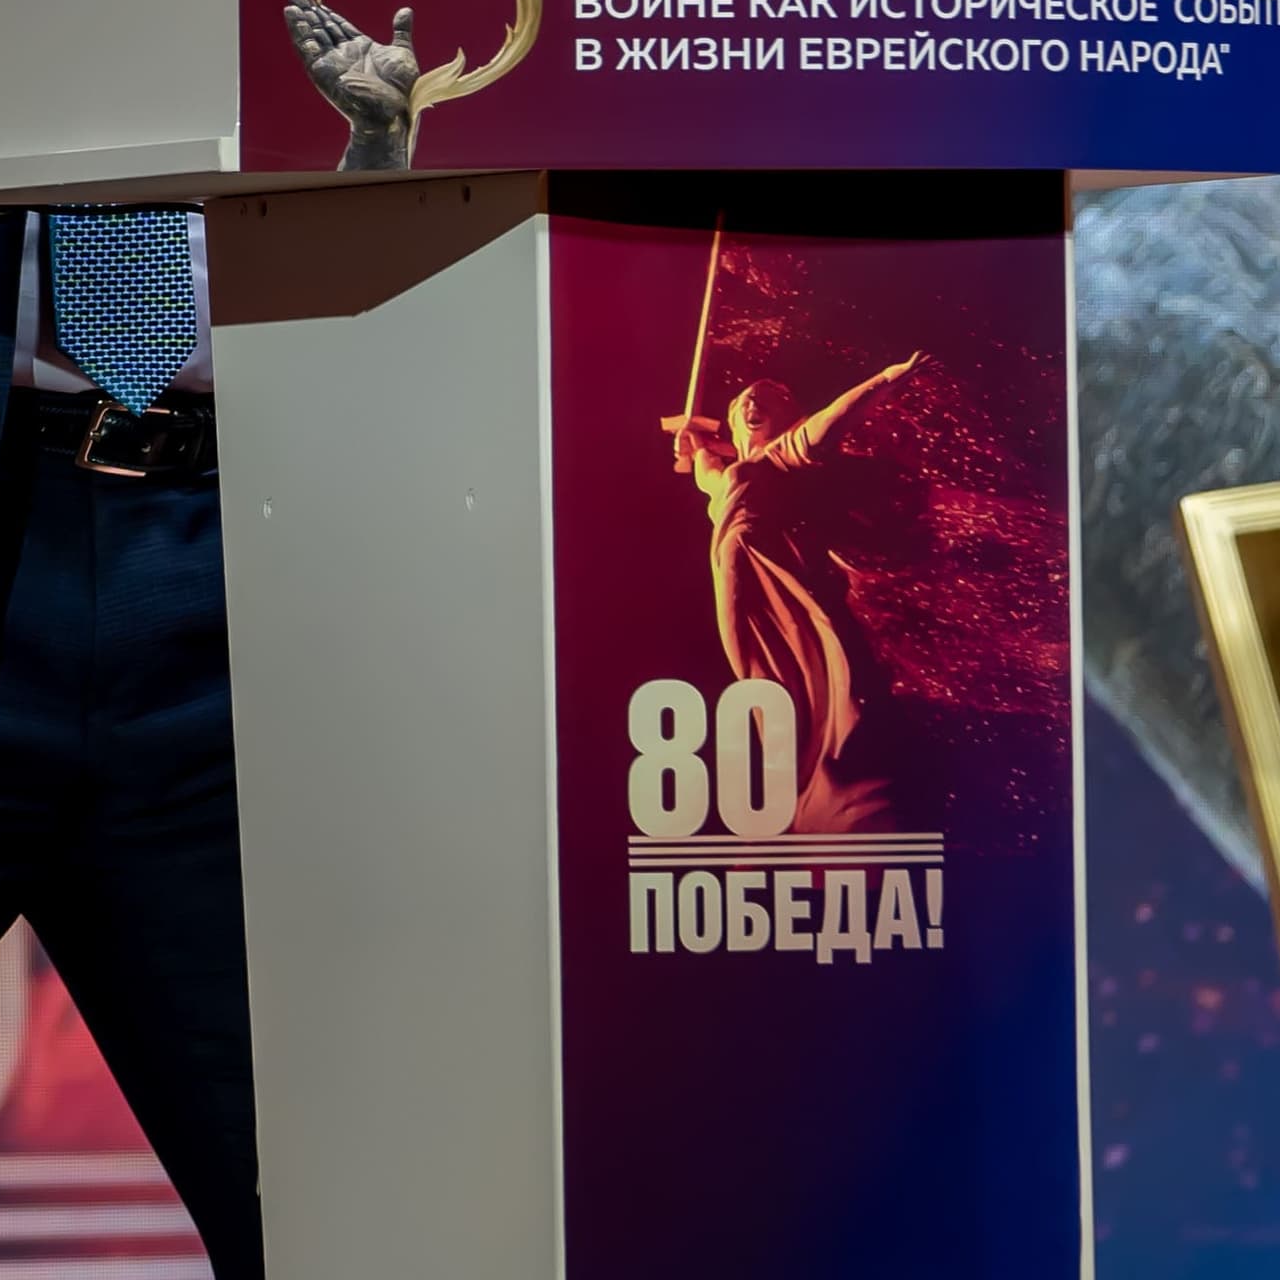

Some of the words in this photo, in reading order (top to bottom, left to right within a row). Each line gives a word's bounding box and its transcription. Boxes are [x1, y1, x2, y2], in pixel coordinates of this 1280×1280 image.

[574, 38, 604, 71] В
[616, 36, 786, 71] ЖИЗНИ
[799, 29, 1070, 72] ЕВРЕЙСКОГО
[1079, 38, 1231, 81] НАРОДА"
[627, 678, 798, 838] 80
[628, 868, 945, 965] ПОБЕДА!
